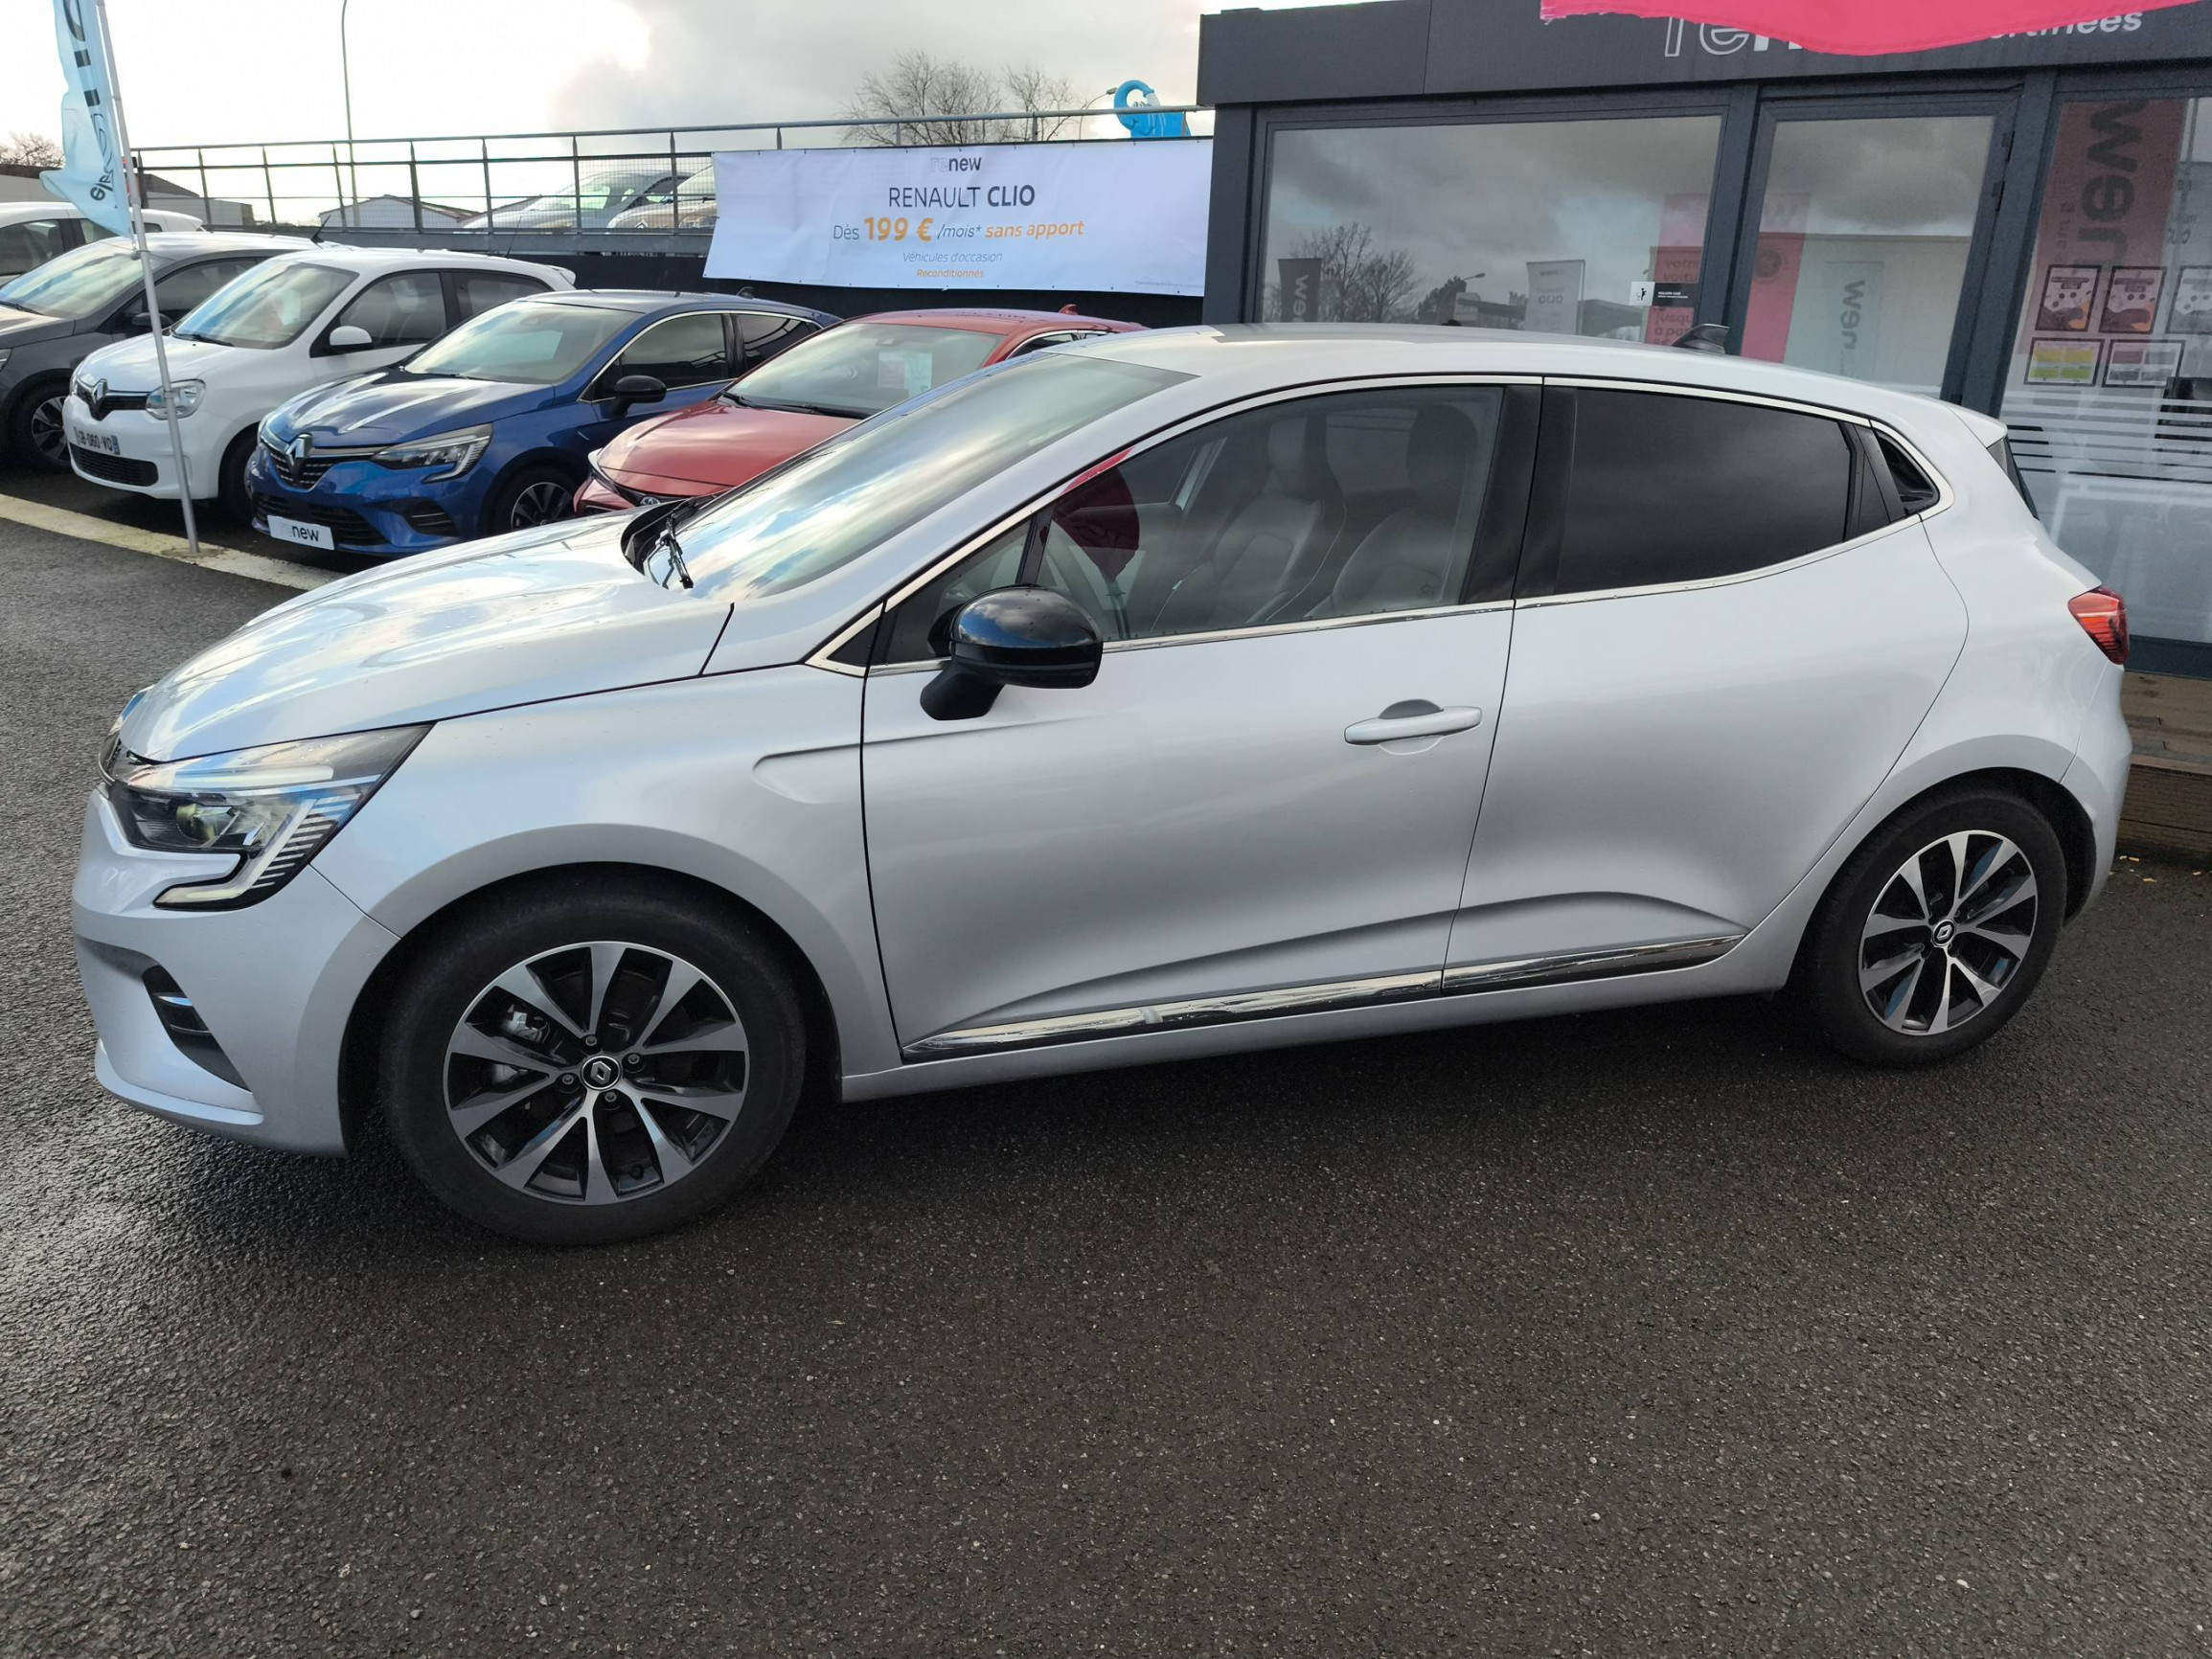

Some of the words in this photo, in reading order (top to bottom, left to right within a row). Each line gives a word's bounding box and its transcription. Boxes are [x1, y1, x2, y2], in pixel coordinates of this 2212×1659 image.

[889, 186, 981, 208] RENAULT
[987, 184, 1036, 207] CLIO
[832, 224, 860, 240] Dès
[864, 217, 909, 241] 199
[916, 217, 935, 242] €
[985, 225, 1023, 239] sans
[1026, 219, 1084, 239] apport
[902, 252, 949, 262] Véhicules
[291, 525, 319, 542] new
